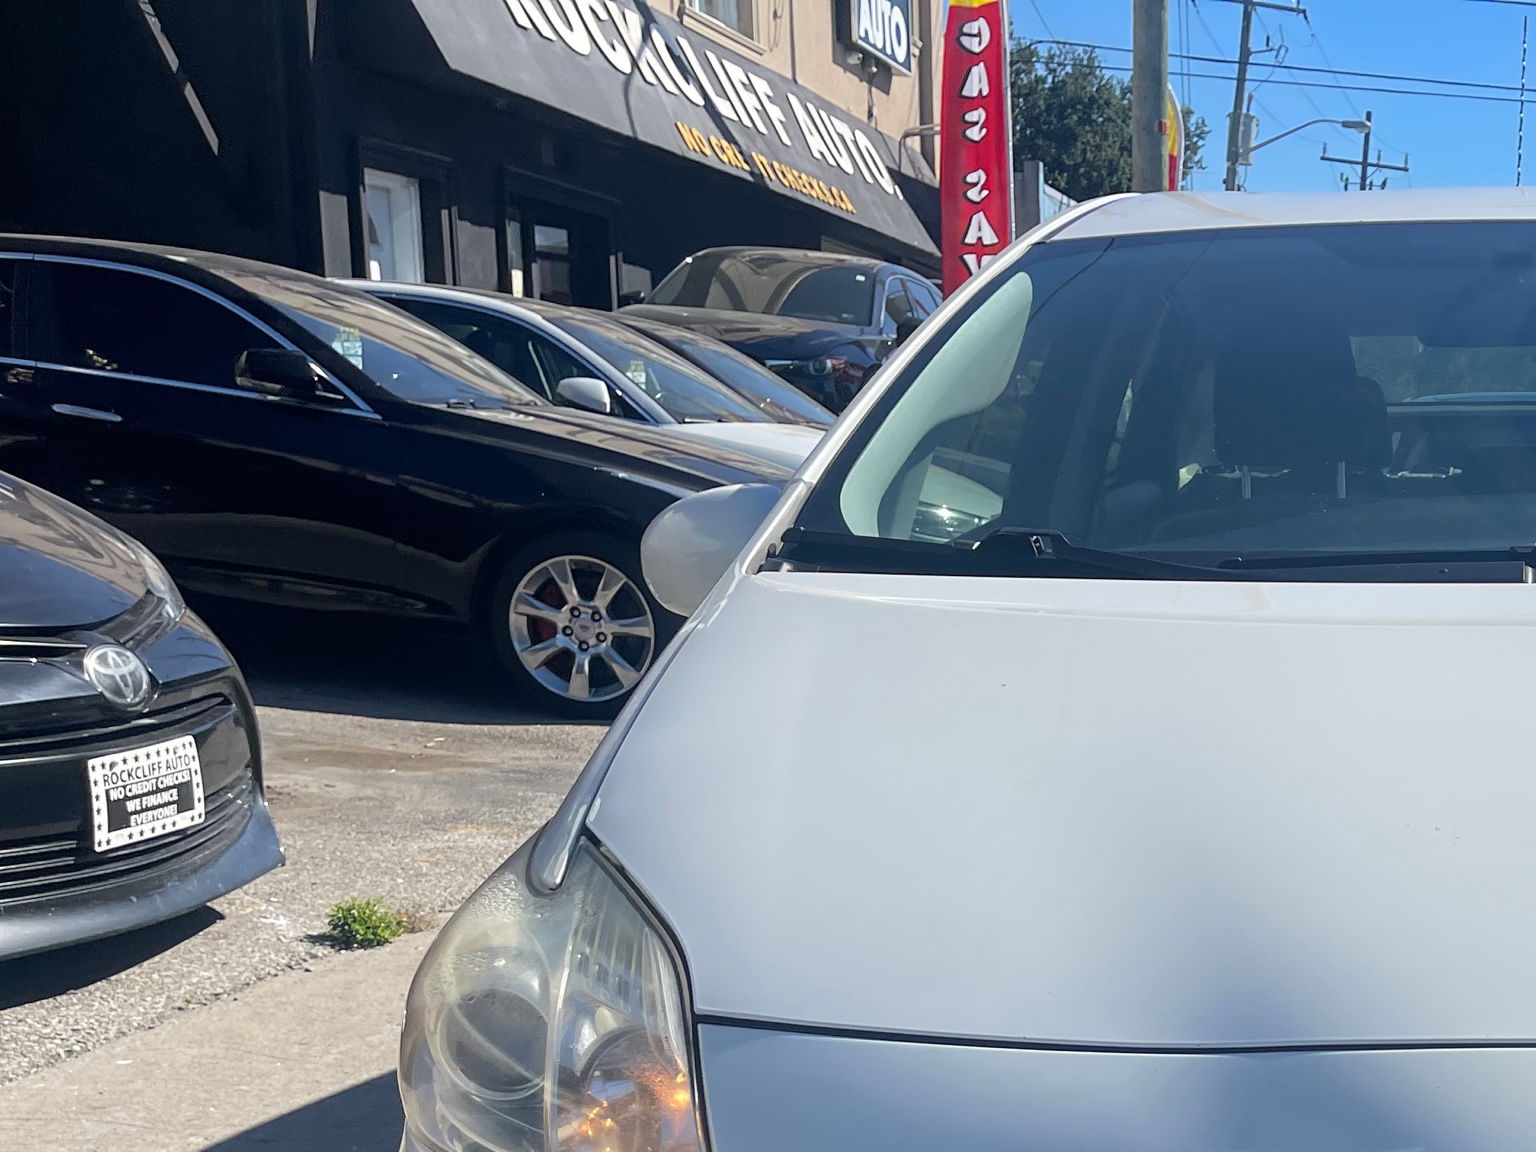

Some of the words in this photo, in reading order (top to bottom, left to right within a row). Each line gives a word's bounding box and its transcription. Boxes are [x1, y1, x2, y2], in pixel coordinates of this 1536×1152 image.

[858, 0, 908, 64] AUTO
[675, 121, 711, 157] NO
[708, 134, 776, 182] CREIT
[103, 761, 162, 787] ROCKCLIFF
[165, 754, 191, 772] AUTO
[109, 787, 125, 801] NO
[125, 779, 158, 797] CREDIT
[157, 769, 191, 788] CHECKS!
[126, 800, 141, 812] WE
[142, 788, 178, 809] FINANCE
[130, 804, 178, 827] EVERYONE!
